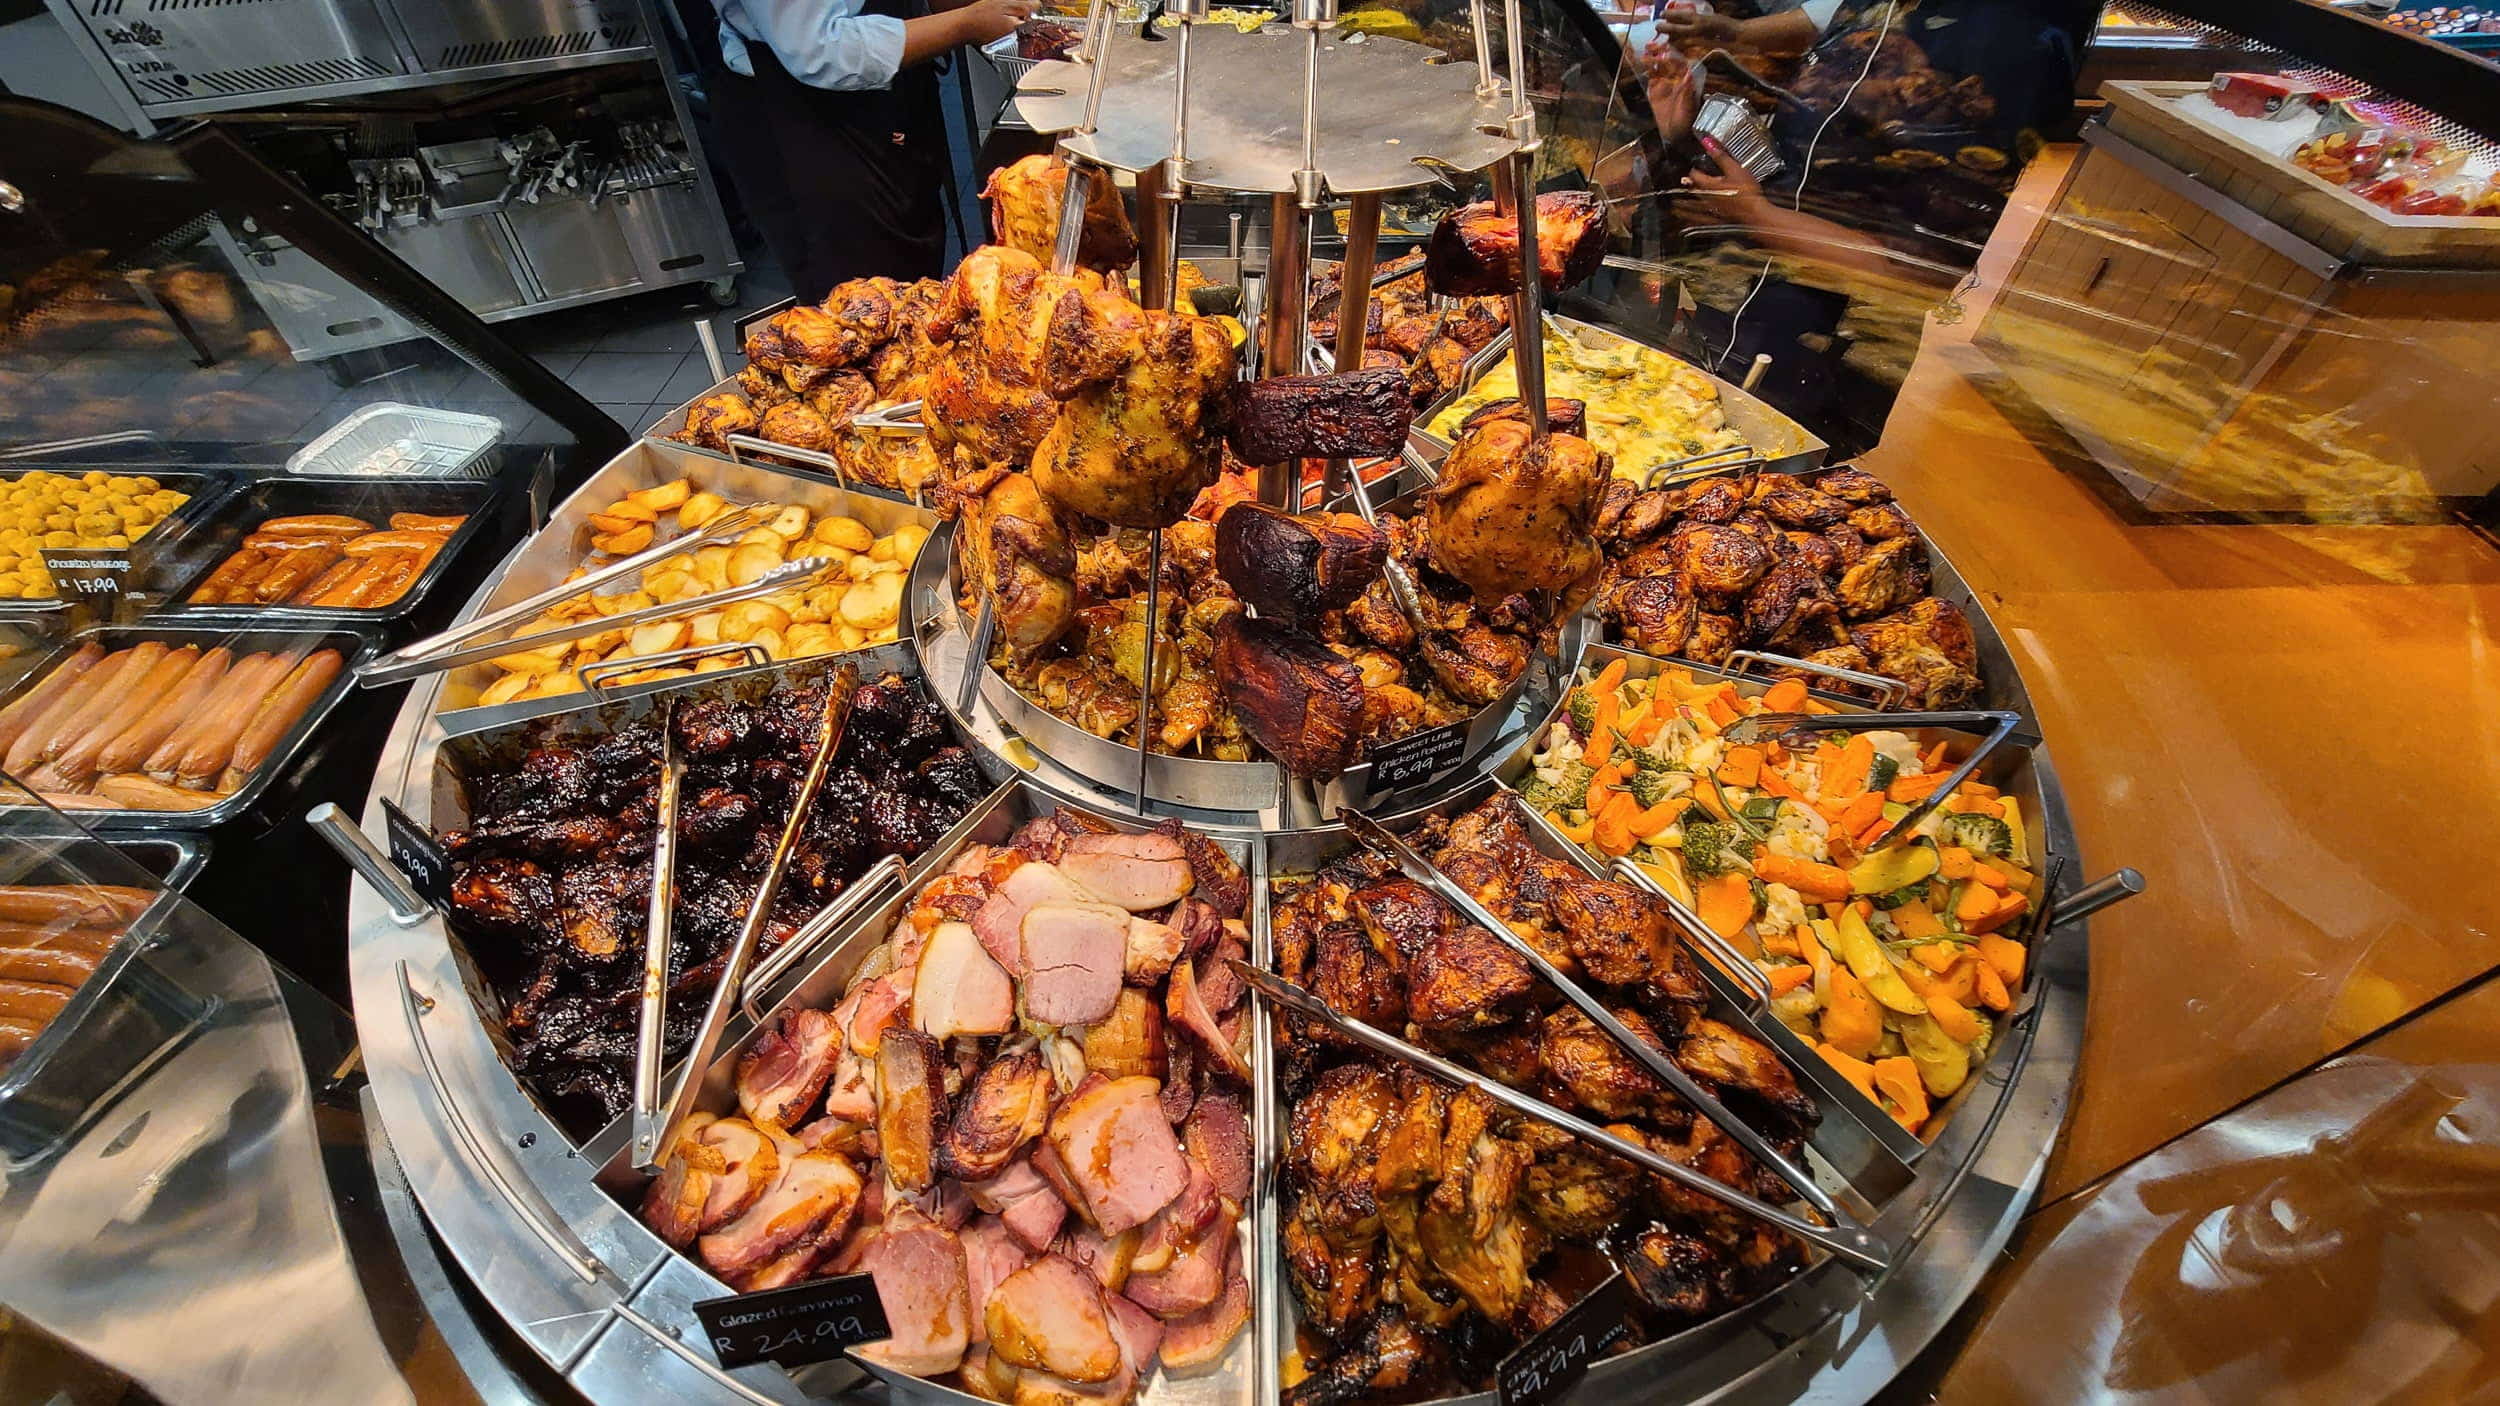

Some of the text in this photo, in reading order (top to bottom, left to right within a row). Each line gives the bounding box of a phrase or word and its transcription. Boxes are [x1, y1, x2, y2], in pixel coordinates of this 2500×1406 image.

[1378, 769, 1387, 780] R
[719, 1307, 778, 1329] Glazed
[715, 1337, 736, 1354] R
